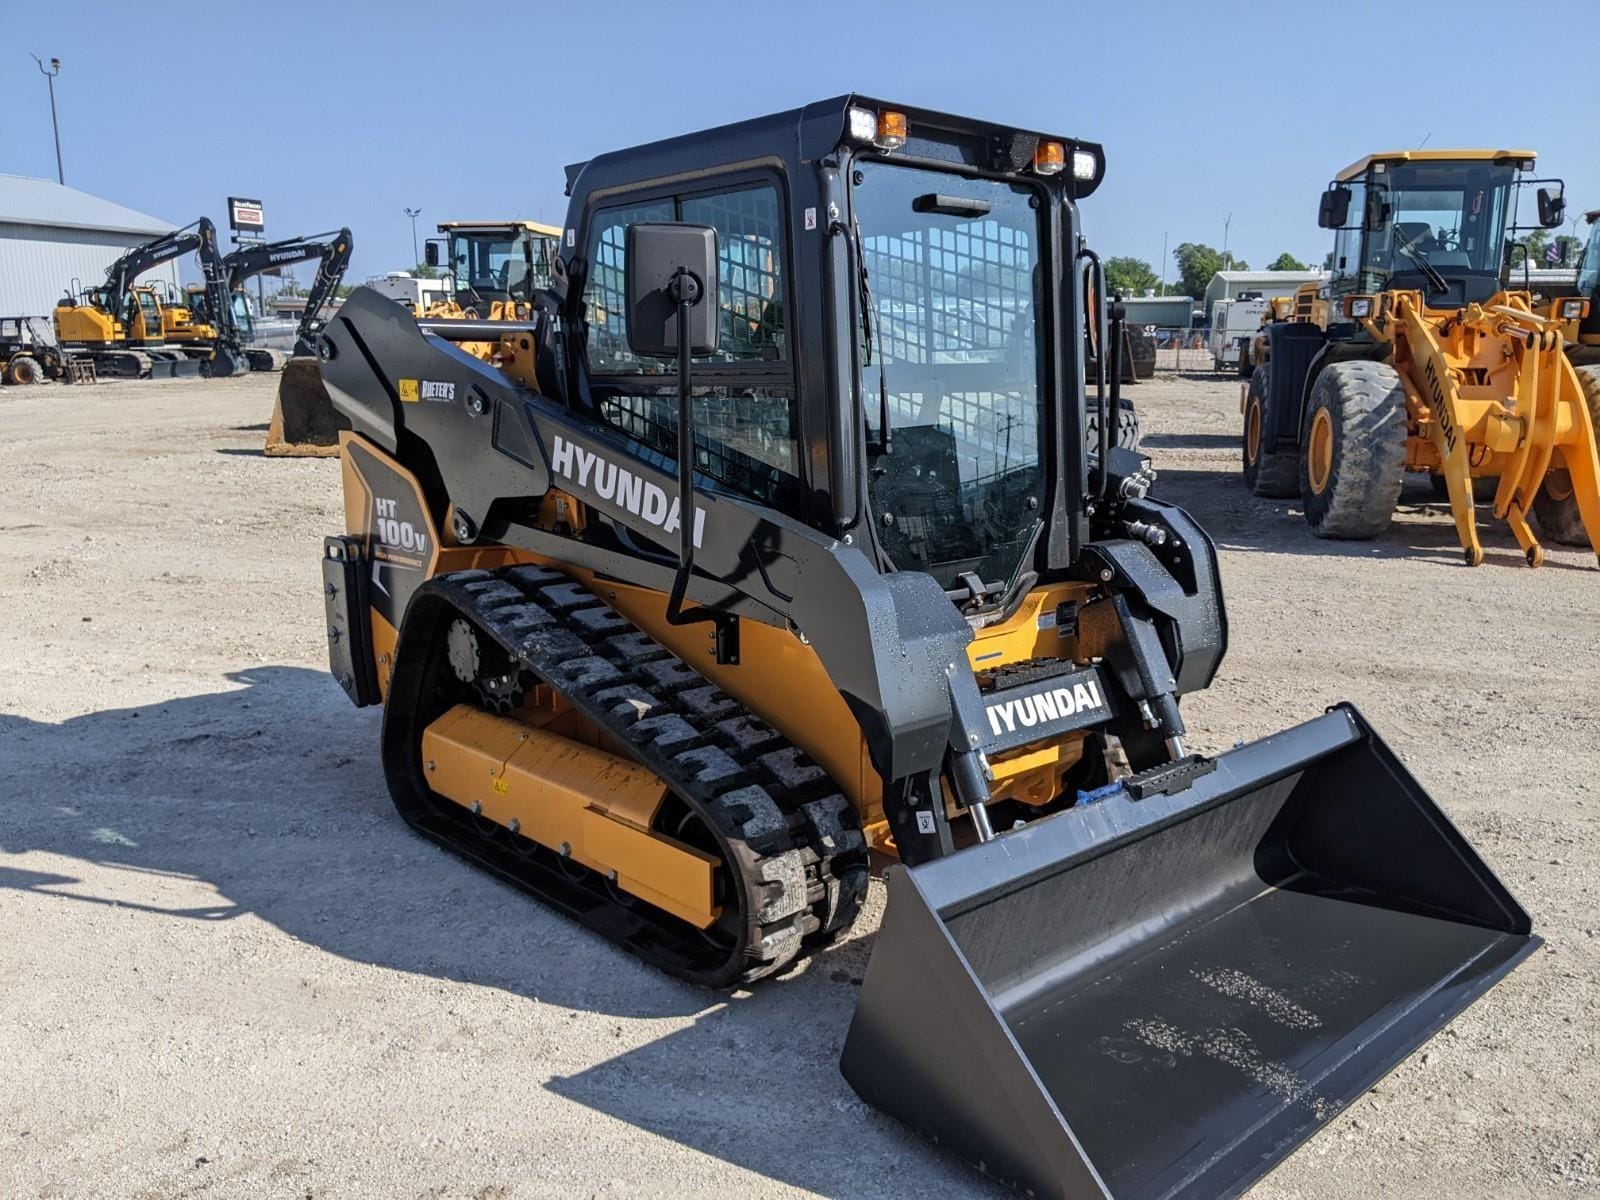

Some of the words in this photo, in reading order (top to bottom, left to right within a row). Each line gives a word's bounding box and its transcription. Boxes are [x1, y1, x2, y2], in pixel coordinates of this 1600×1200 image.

[153, 246, 178, 259] HYUNDAI
[269, 249, 305, 262] HYUNDAI
[1425, 357, 1456, 452] HYUNDAI
[552, 435, 706, 549] HYUNDAI
[376, 497, 396, 518] HT
